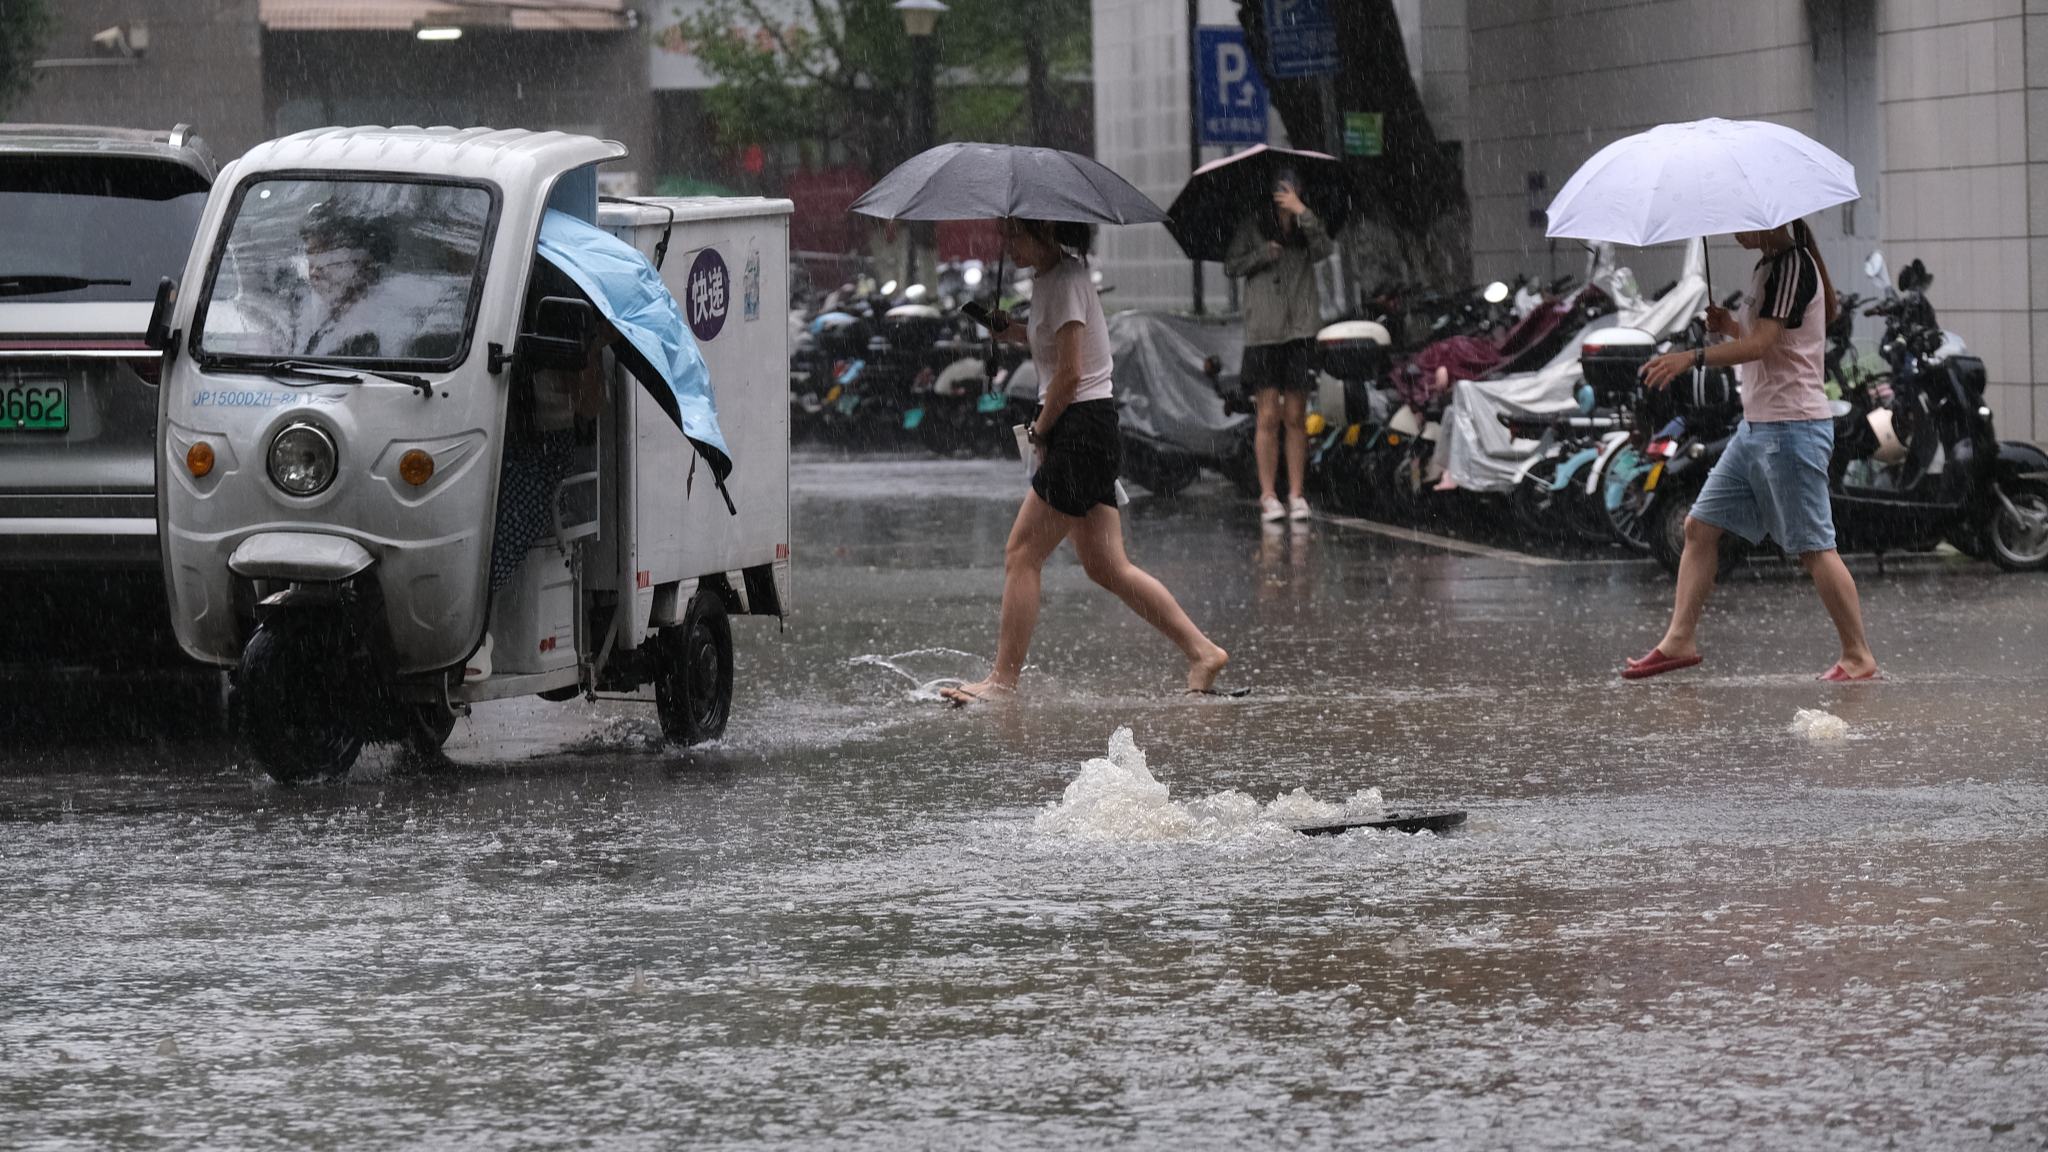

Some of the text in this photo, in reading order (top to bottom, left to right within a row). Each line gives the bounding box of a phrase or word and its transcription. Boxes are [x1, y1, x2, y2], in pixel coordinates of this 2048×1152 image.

[1216, 43, 1247, 105] P
[691, 265, 725, 325] 快递
[0, 387, 62, 421] 662
